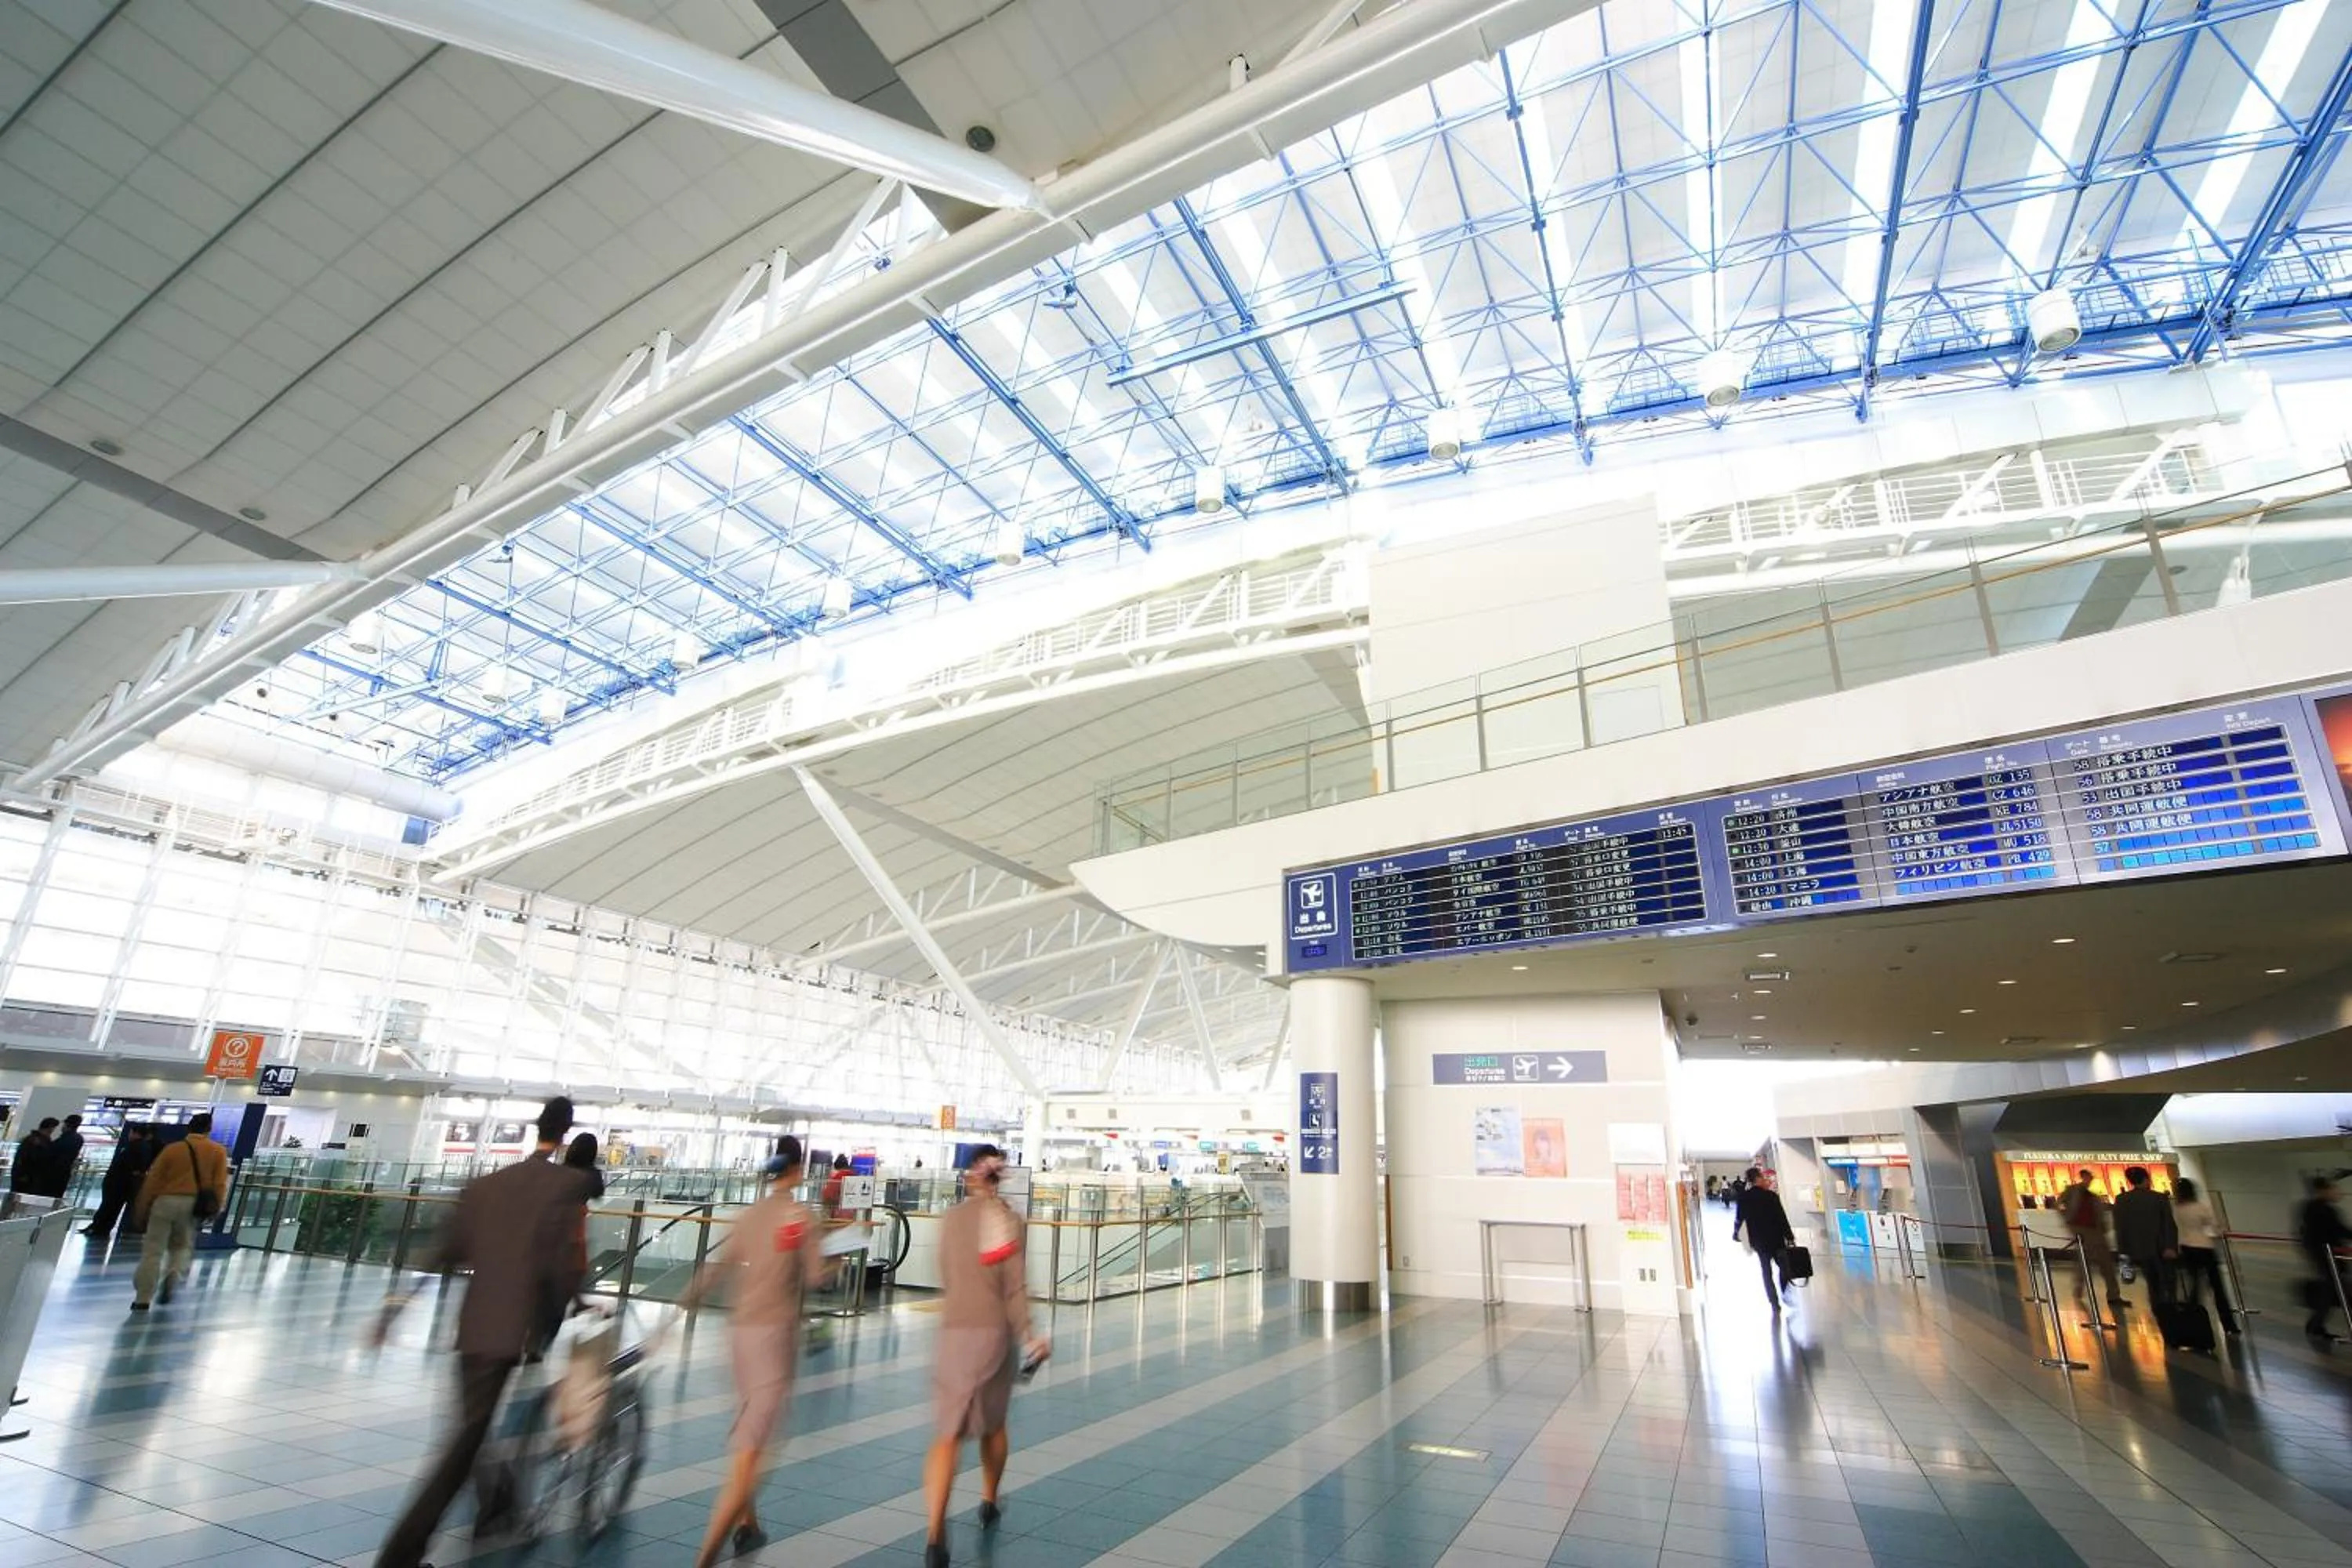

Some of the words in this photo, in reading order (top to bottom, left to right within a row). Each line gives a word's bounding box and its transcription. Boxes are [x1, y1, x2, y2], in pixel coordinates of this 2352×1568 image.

[1882, 797, 1959, 818] 中国南方航空
[1992, 789, 2007, 800] CZ
[1887, 816, 1936, 833] 大韓航空
[1996, 805, 2010, 816] KE
[2016, 801, 2038, 813] 784
[2082, 792, 2098, 804] 53
[2105, 779, 2182, 800] 出国手続中
[1890, 831, 1940, 848] 日本航空
[2109, 795, 2188, 816] 共同運航便
[1892, 843, 1970, 863] 中国東方航空
[2024, 833, 2047, 846] 518
[1787, 879, 1820, 891] マニラ
[1896, 857, 1987, 878] フィリピン航空
[1294, 924, 1332, 934] Departures
